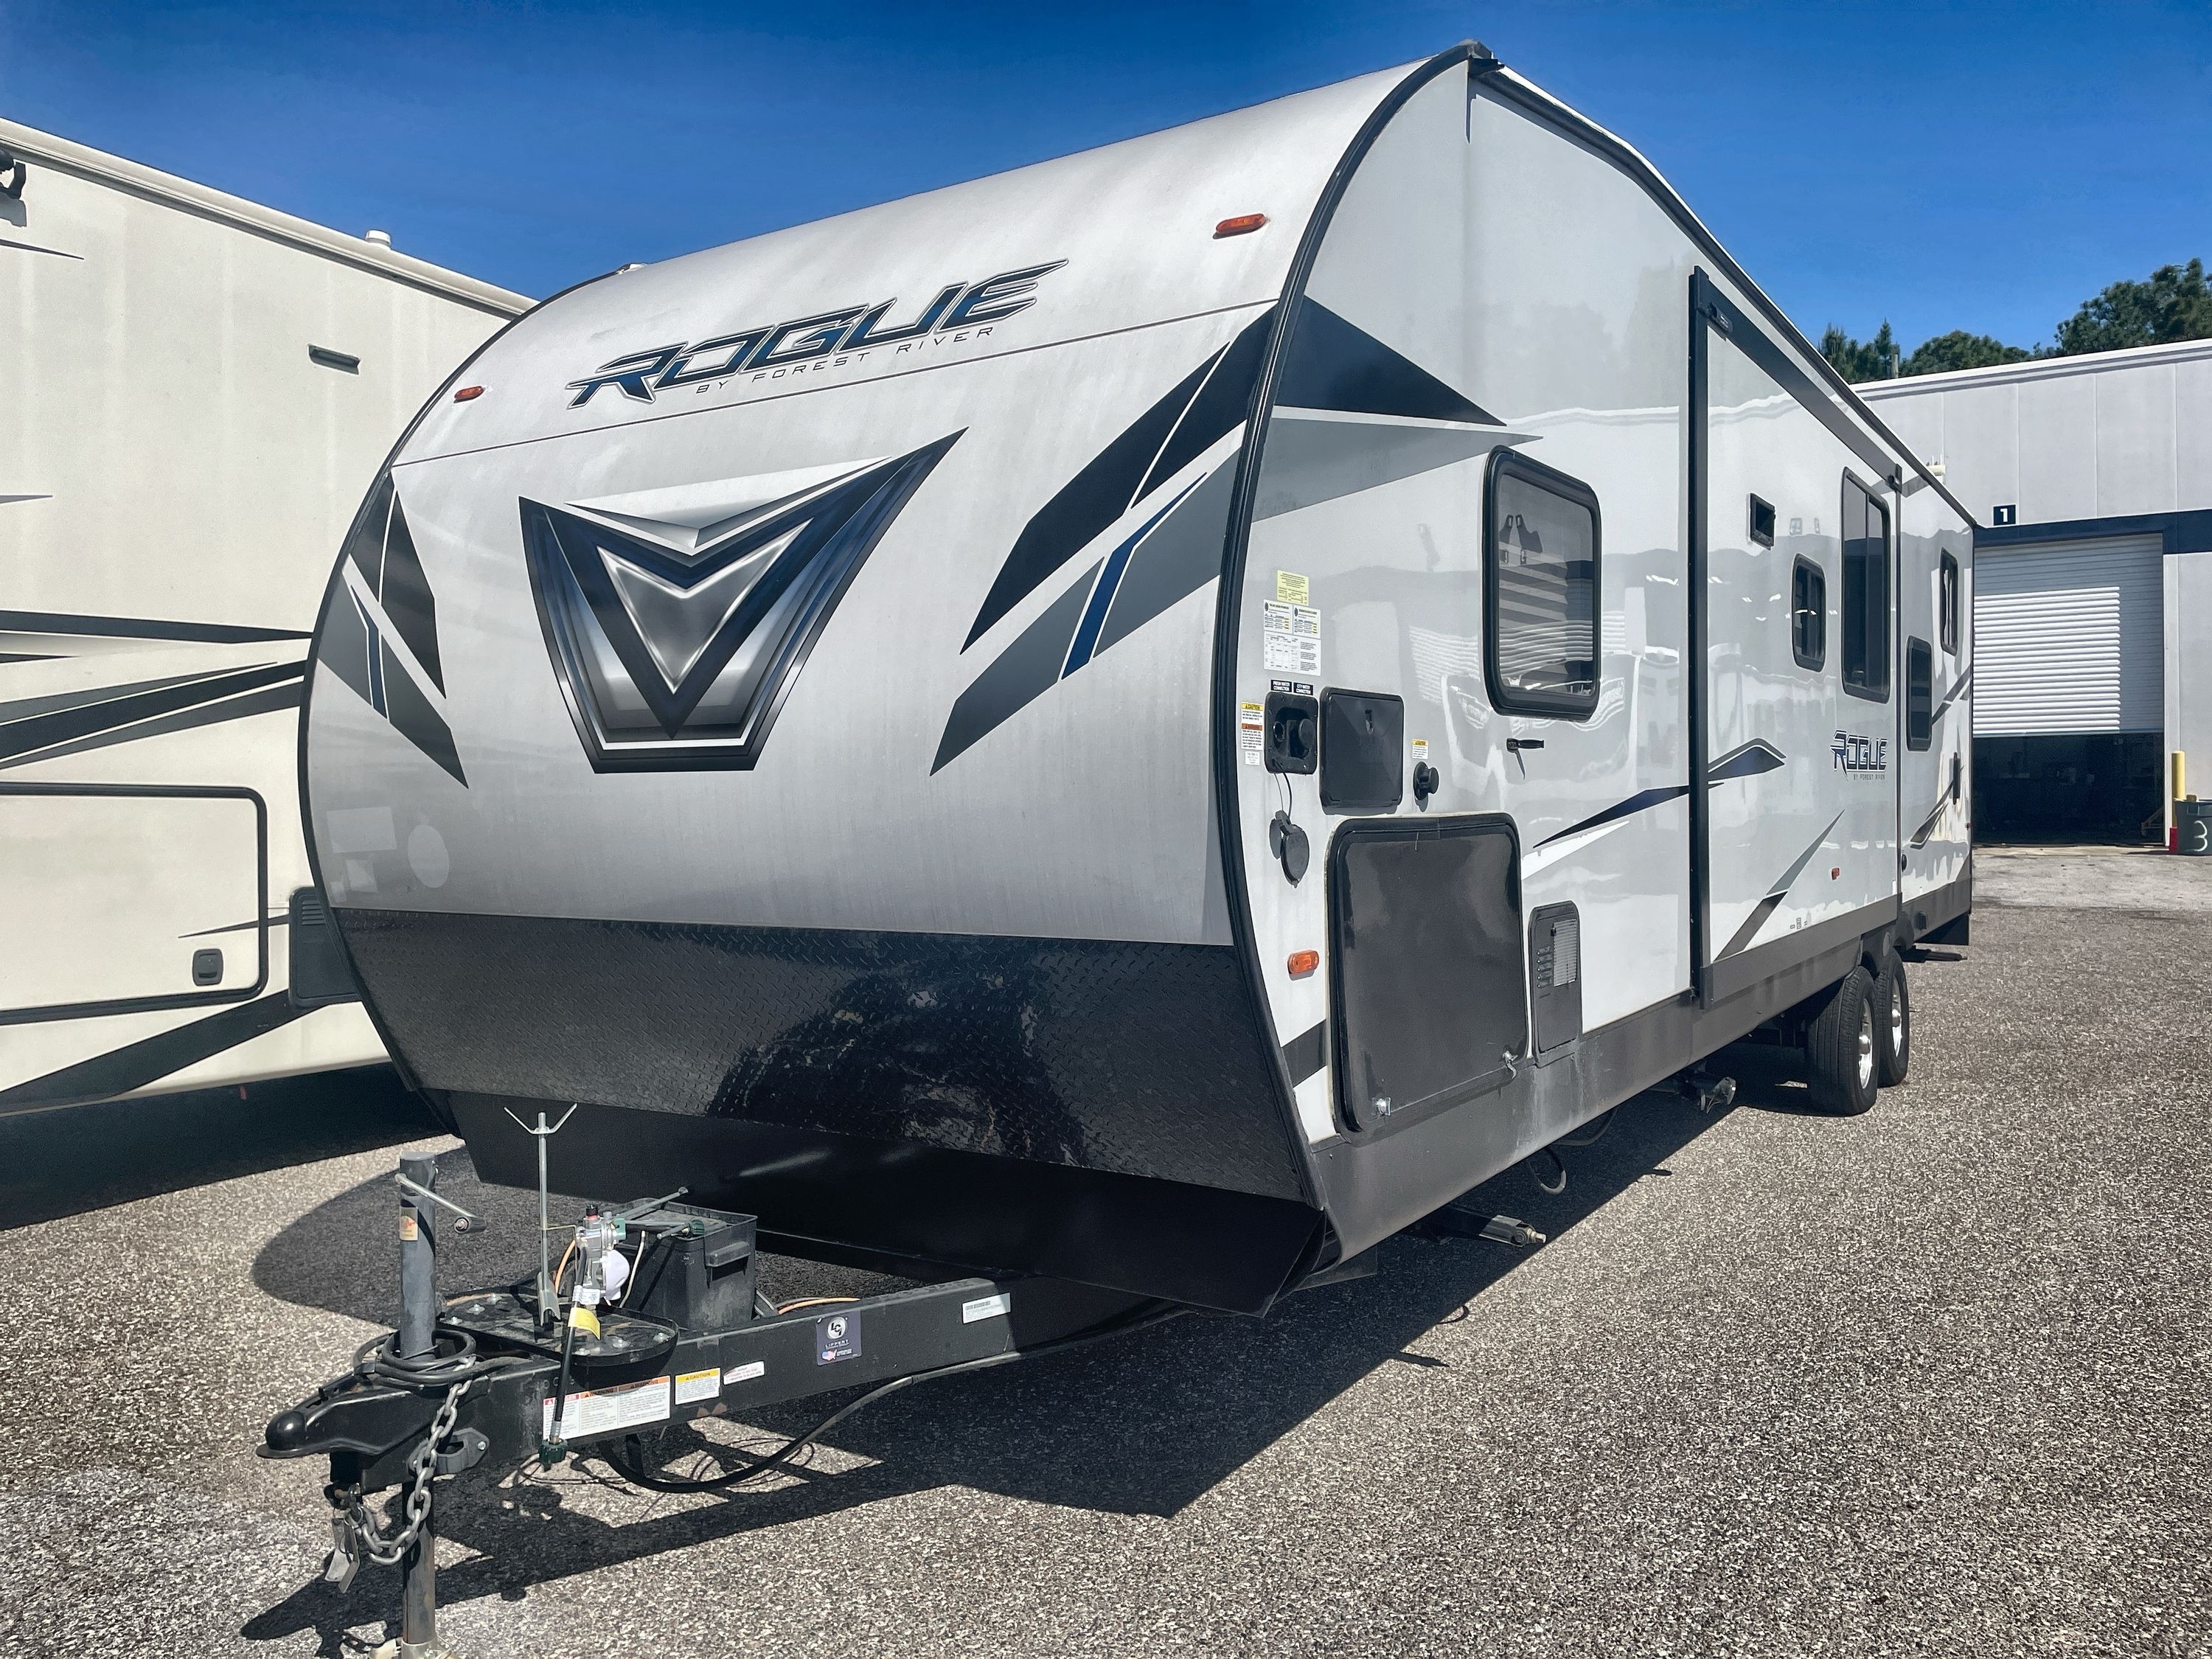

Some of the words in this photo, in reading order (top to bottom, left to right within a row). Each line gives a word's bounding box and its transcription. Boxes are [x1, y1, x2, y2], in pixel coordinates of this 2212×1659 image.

[566, 258, 1069, 410] ROGUE
[695, 380, 729, 394] BY
[751, 352, 871, 383] FOREST
[896, 327, 994, 355] RIVER
[2000, 508, 2008, 523] 1
[1830, 729, 1888, 781] ROGUE
[2194, 820, 2208, 852] 3
[825, 1339, 849, 1348] LIPPERT
[689, 1371, 711, 1380] CAUTION
[634, 1380, 658, 1389] WARNING
[589, 1388, 614, 1397] WARNING
